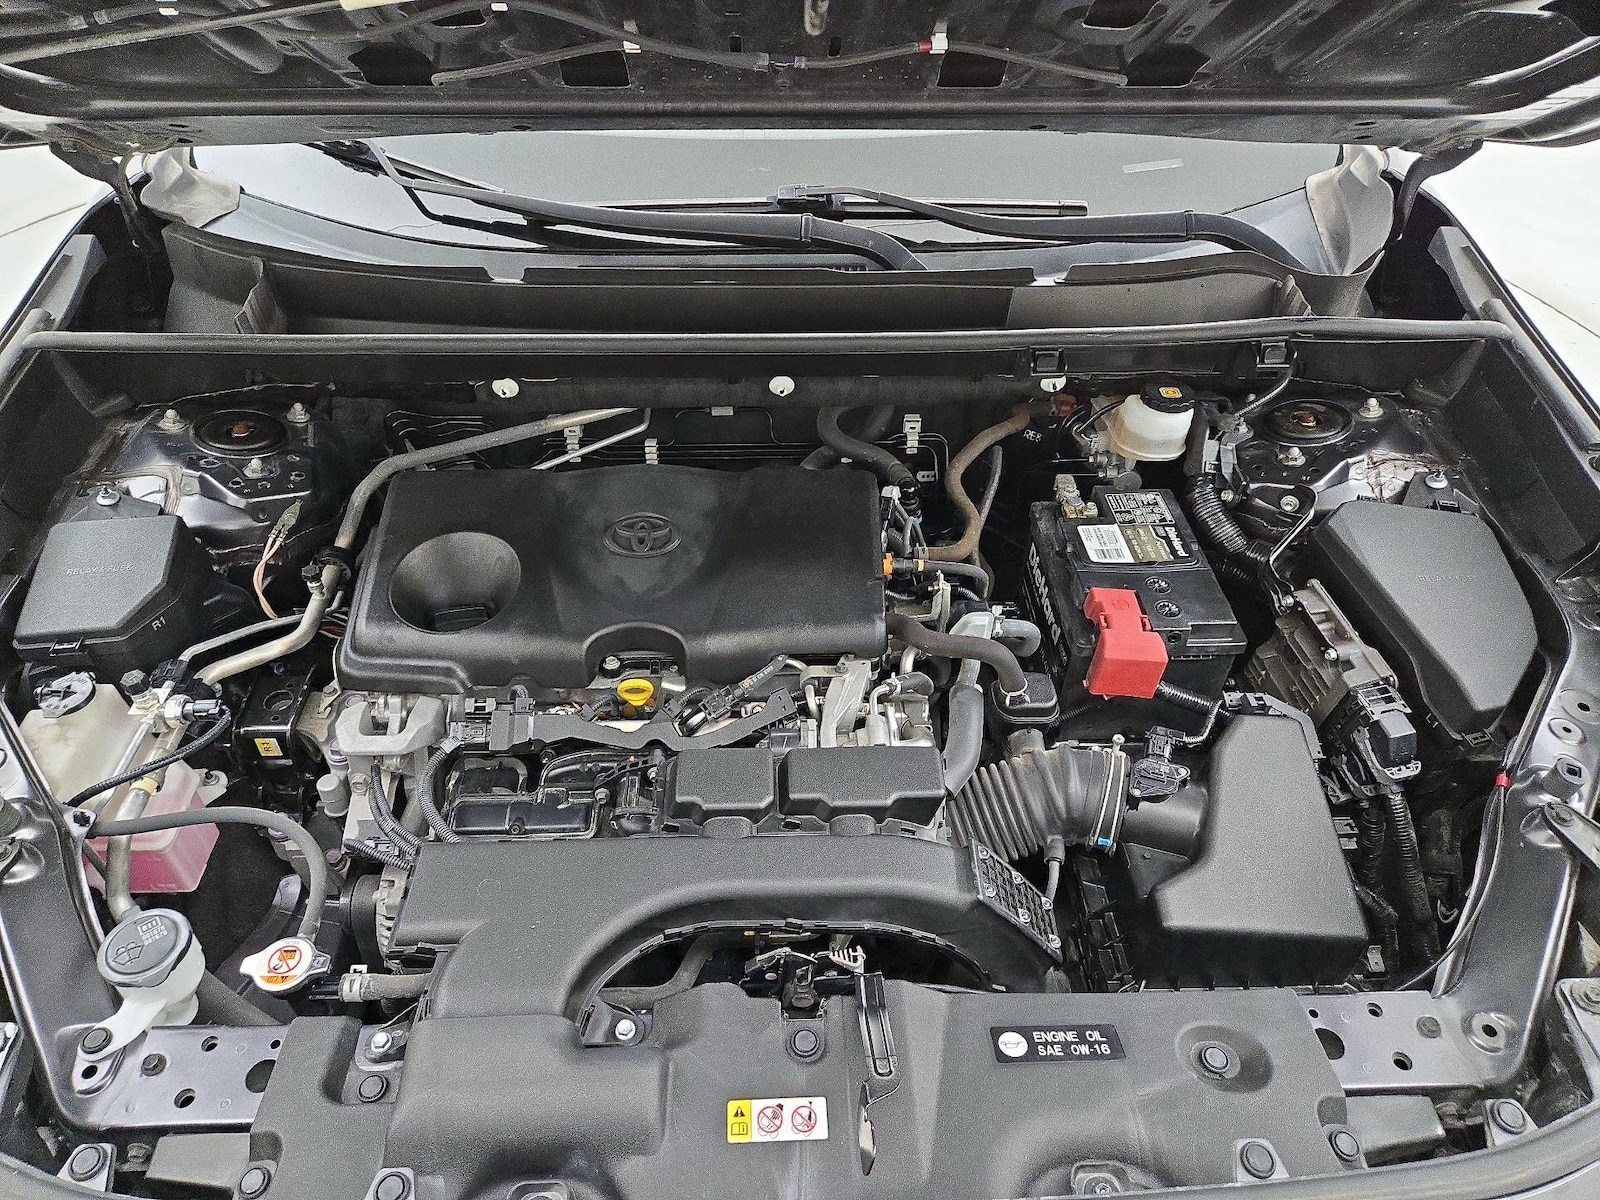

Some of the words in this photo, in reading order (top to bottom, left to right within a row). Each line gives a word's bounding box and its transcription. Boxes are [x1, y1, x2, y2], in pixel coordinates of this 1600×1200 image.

[1164, 526, 1189, 557] DieHard
[1028, 541, 1061, 646] DieHard
[152, 616, 166, 631] R1
[1032, 1031, 1080, 1042] ENGINE
[1085, 1030, 1107, 1042] OIL
[1037, 1044, 1064, 1056] SAE
[1070, 1043, 1111, 1055] 0W-16
